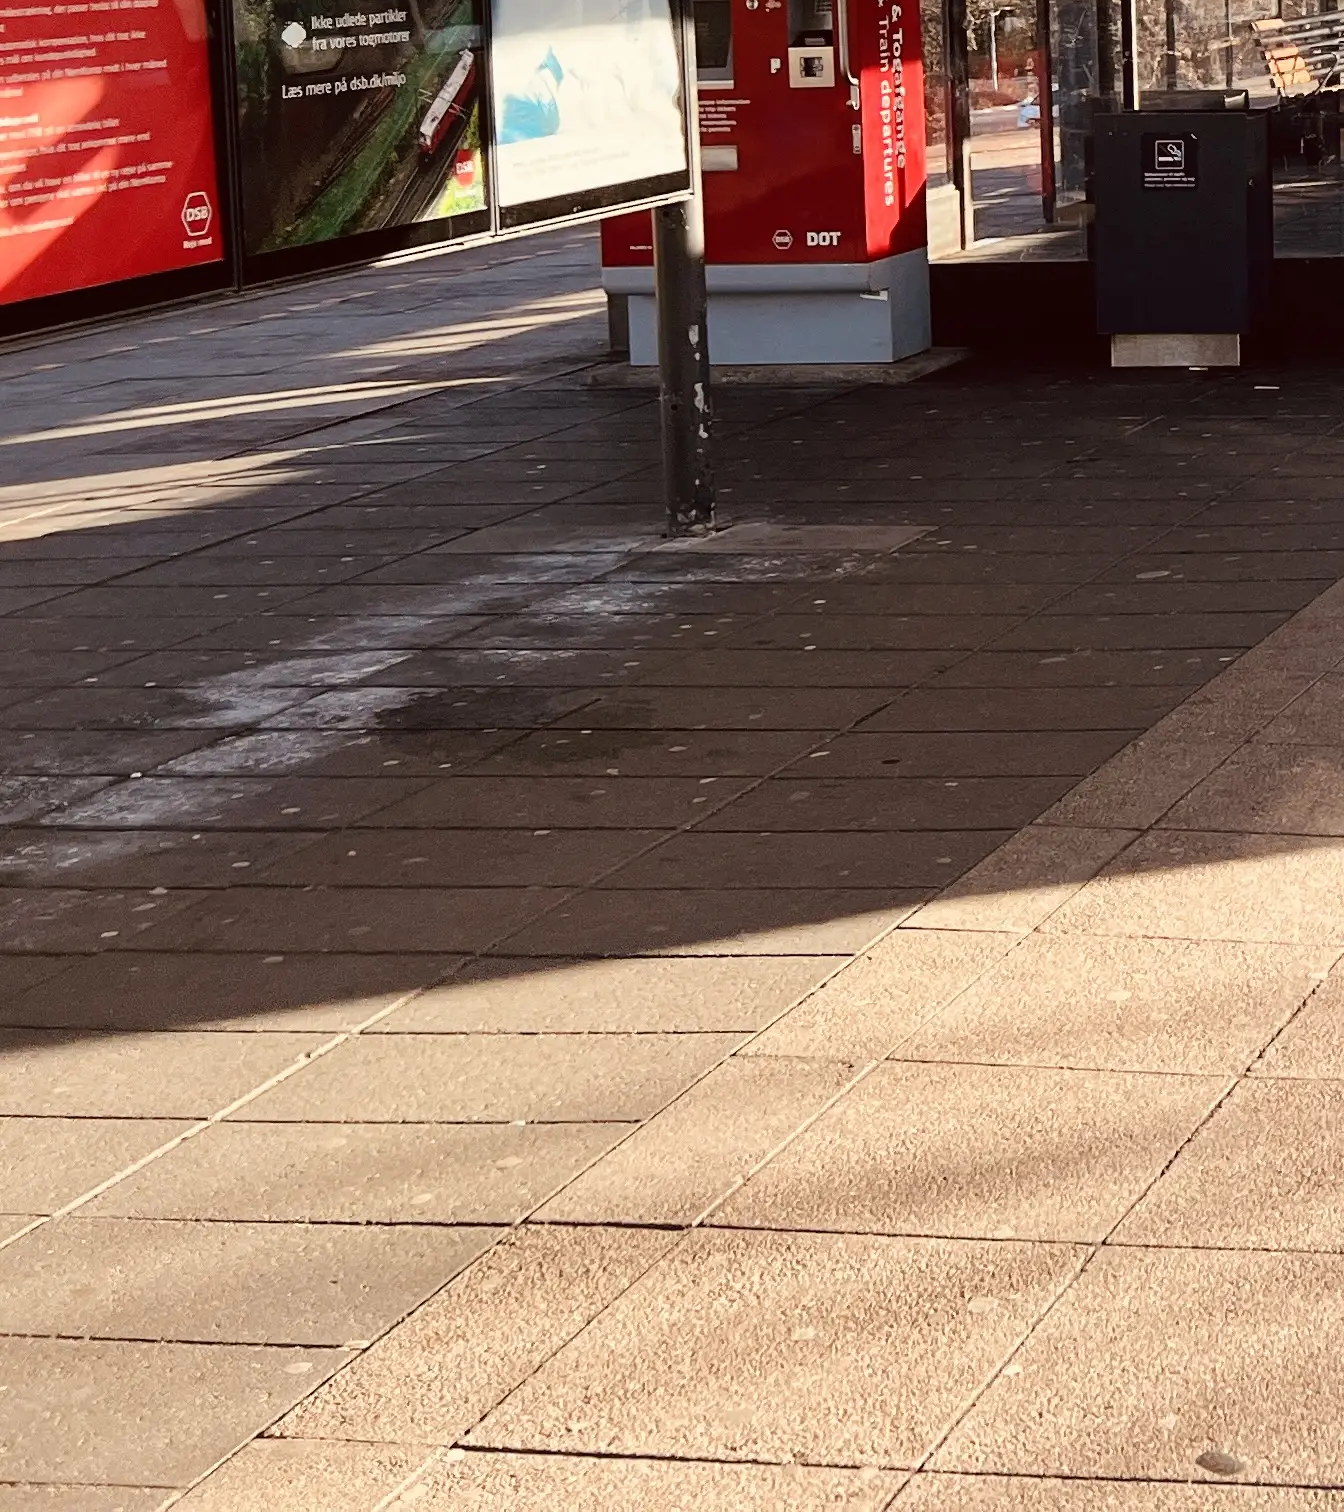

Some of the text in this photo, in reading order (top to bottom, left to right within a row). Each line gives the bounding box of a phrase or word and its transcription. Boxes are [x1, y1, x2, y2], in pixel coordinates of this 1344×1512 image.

[311, 8, 407, 30] Ikke udlede partikler
[891, 5, 902, 22] &
[312, 30, 411, 52] fra vores togmotorer
[878, 15, 890, 72] Train
[282, 83, 303, 99] Læs
[305, 81, 333, 97] mere
[334, 76, 349, 96] på
[892, 28, 906, 168] Togafgange
[880, 80, 894, 207] departures
[186, 206, 209, 222] DSB
[807, 232, 842, 246] DOT
